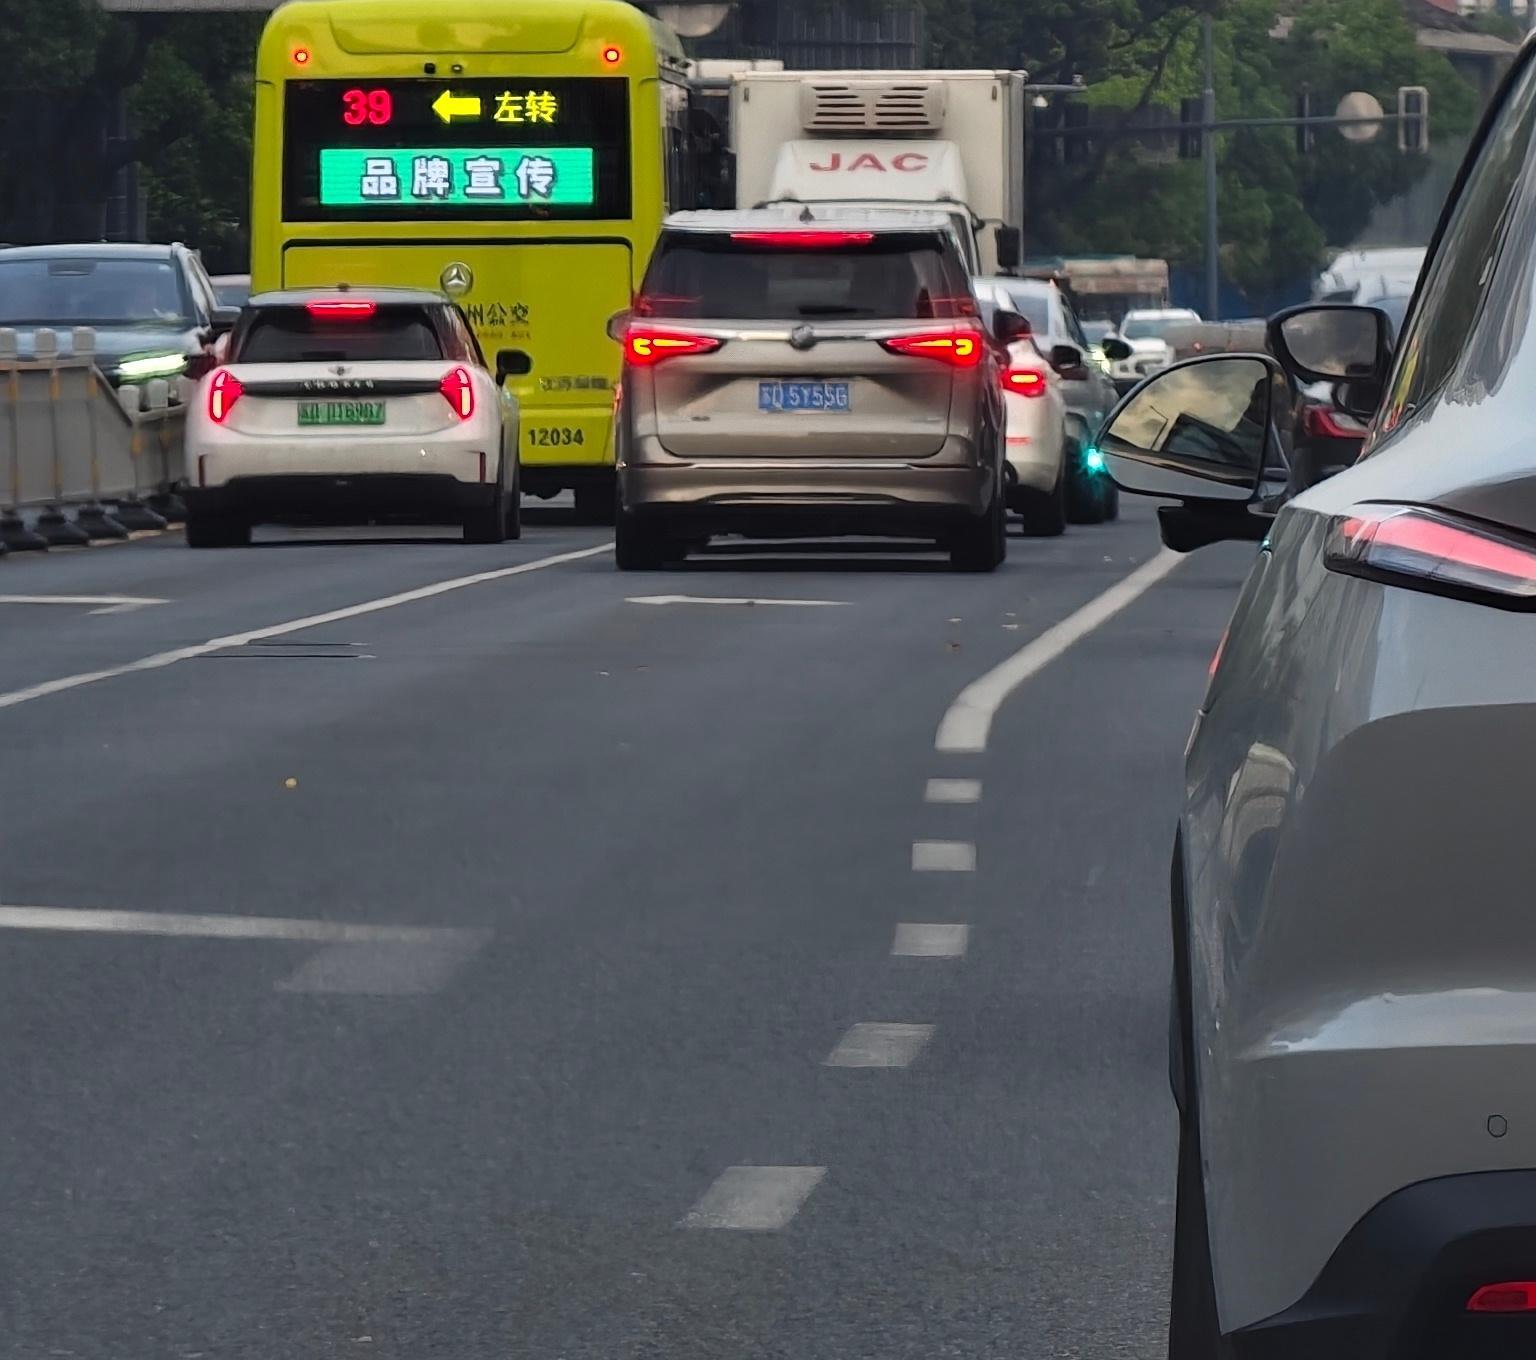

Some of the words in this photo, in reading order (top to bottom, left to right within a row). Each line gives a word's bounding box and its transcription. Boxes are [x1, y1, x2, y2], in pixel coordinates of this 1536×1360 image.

[342, 89, 393, 126] 39
[494, 89, 559, 125] 左转
[809, 151, 929, 173] JAC
[360, 155, 556, 199] 品牌宣传
[528, 428, 584, 447] 12034
